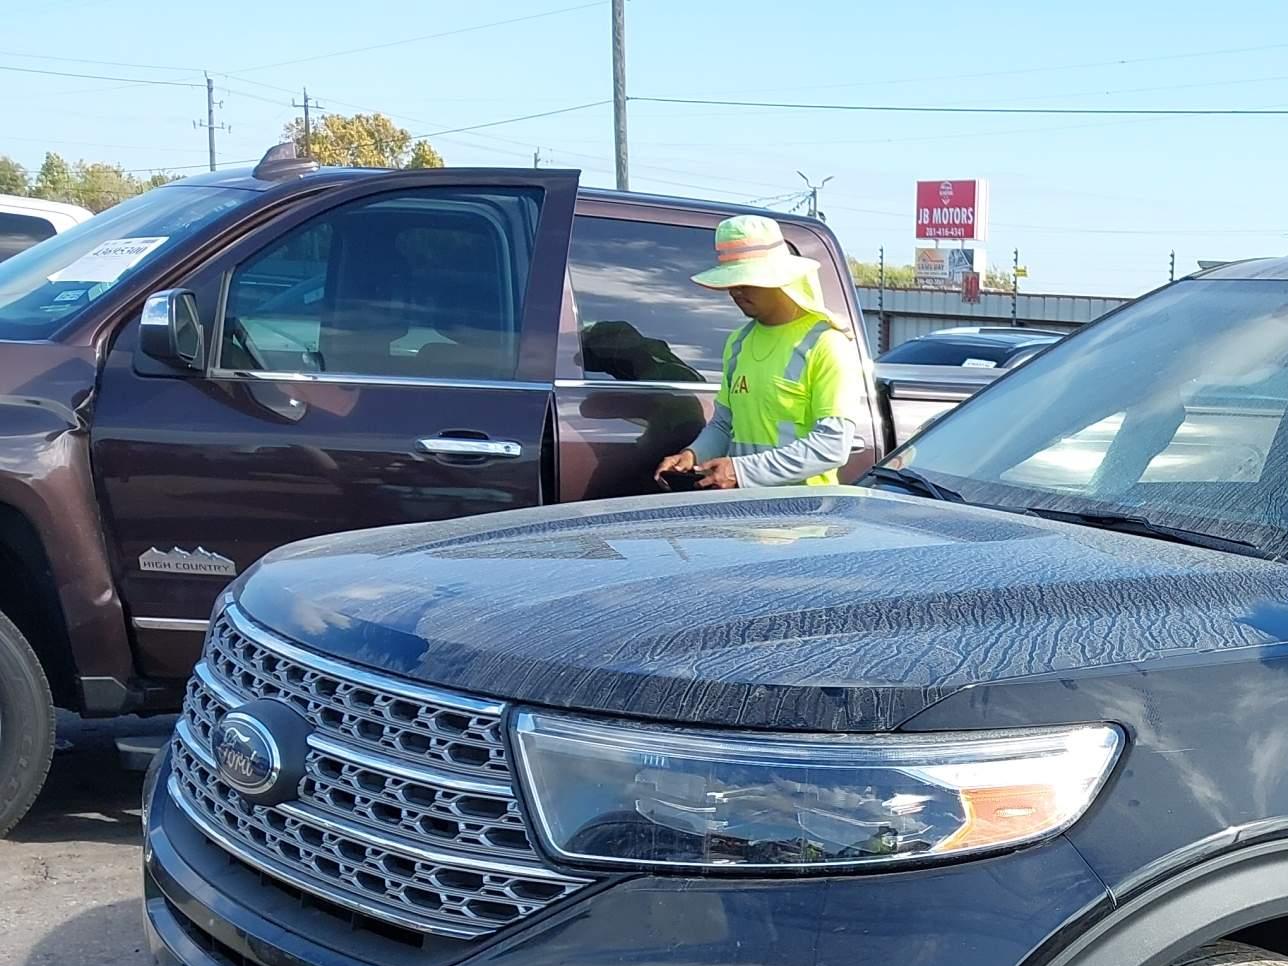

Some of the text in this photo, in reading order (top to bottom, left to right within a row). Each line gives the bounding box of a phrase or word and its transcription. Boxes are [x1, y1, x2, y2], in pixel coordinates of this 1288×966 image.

[918, 207, 973, 225] JB MOTORS
[143, 561, 230, 572] HIGH COUNTRY
[217, 726, 258, 777] Ford
